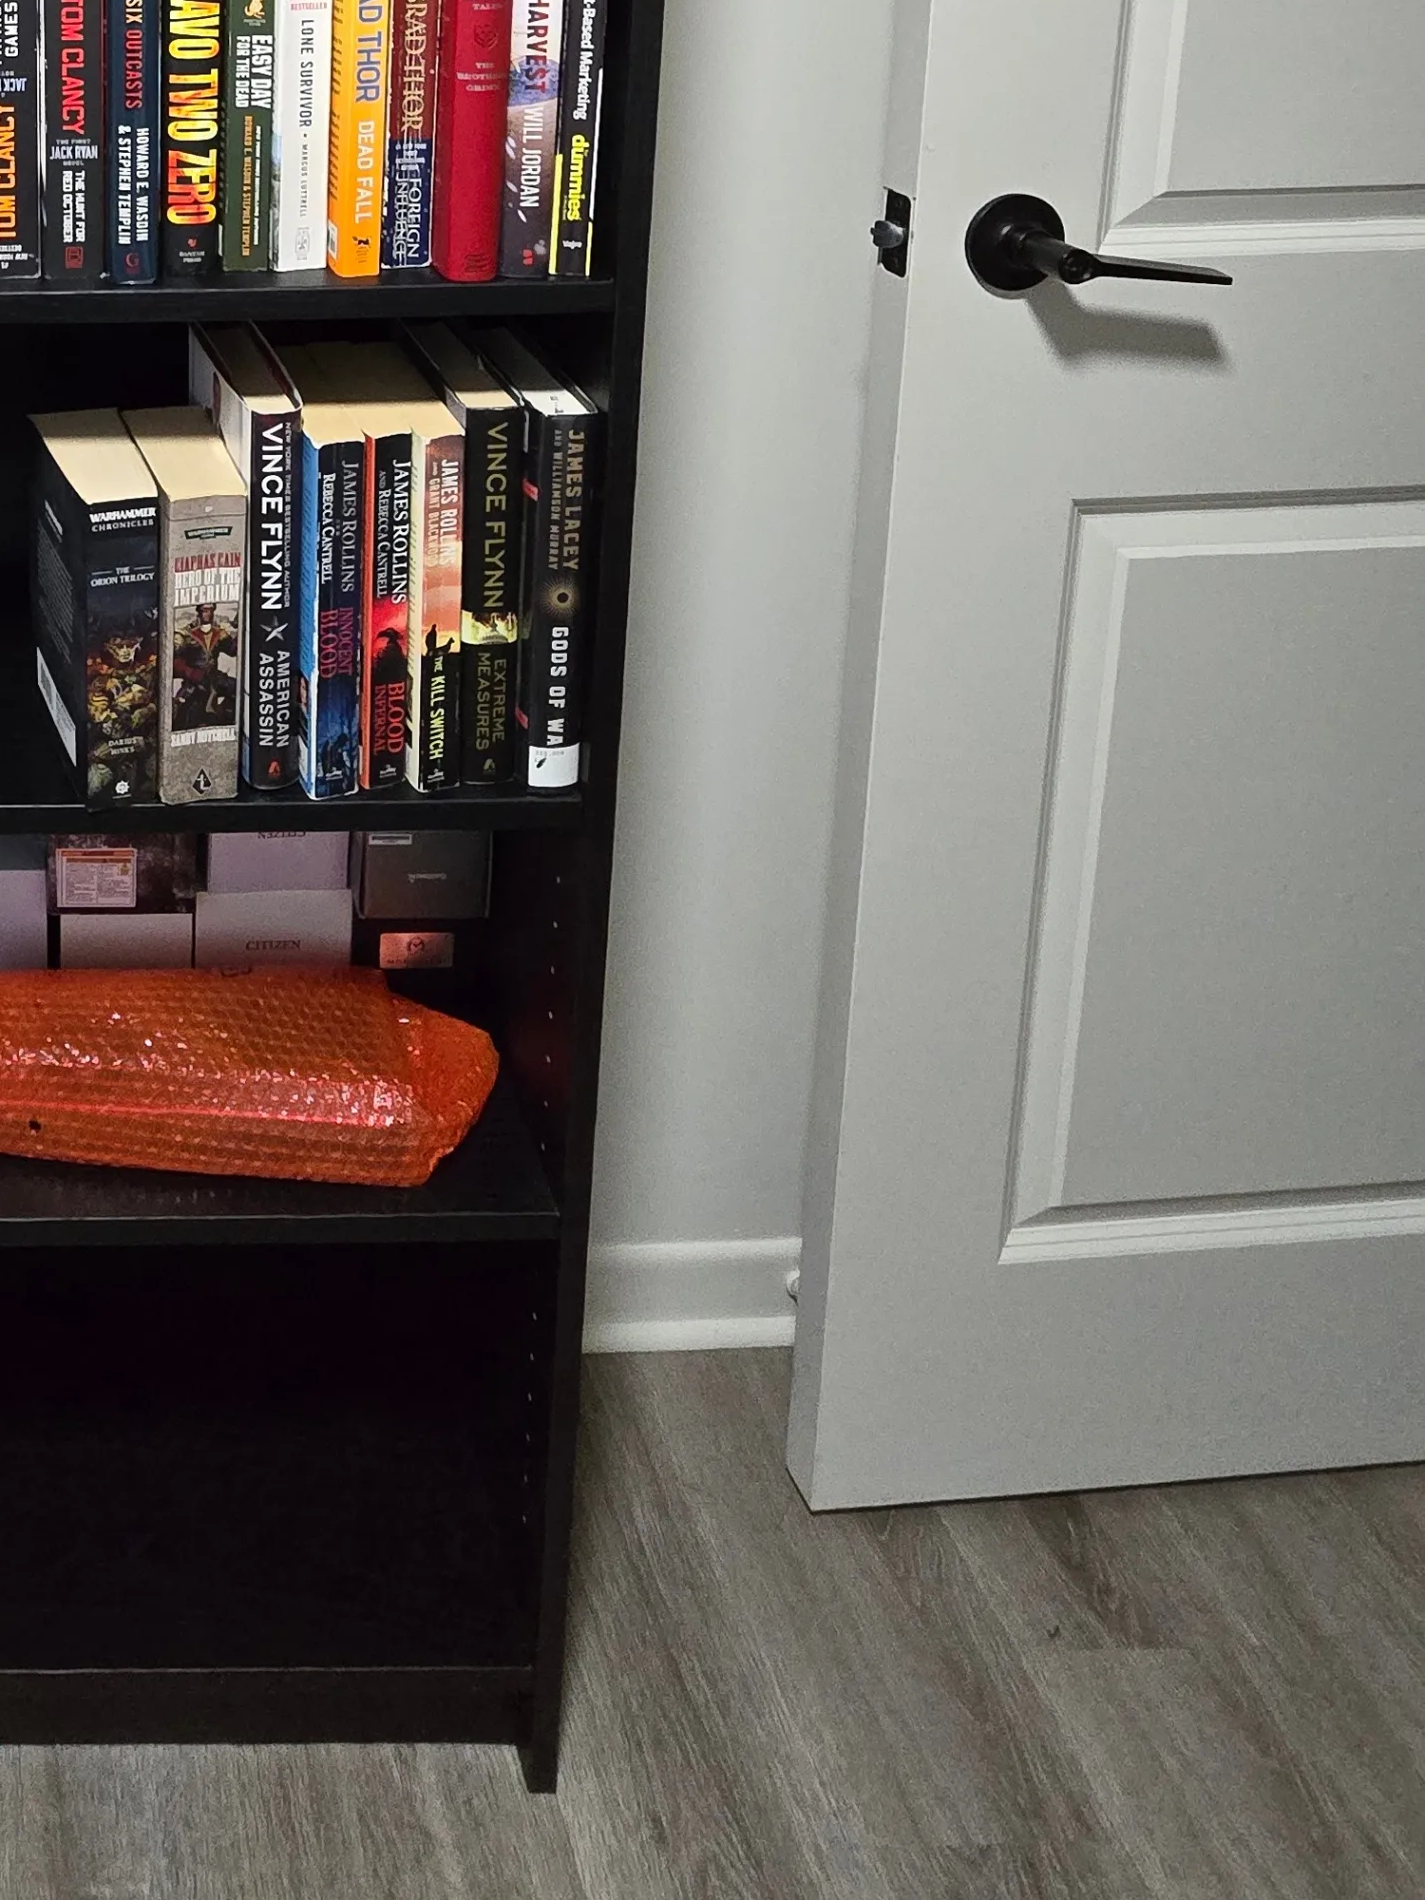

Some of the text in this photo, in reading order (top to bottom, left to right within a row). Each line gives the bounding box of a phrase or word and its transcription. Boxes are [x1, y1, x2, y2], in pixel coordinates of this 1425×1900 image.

[4, 2, 18, 58] GAMES
[291, 2, 327, 11] BESTSELLER
[125, 29, 142, 109] OUTCASTS
[251, 34, 273, 107] EASY DAY
[300, 20, 313, 127] LONE SURVIVOR
[355, 31, 382, 102] THOR
[526, 0, 553, 94] HARVEST
[61, 47, 85, 134] CLANCY
[169, 70, 218, 142] TWO
[357, 122, 374, 168] DEAD
[522, 106, 544, 143] WILL
[168, 149, 217, 224] ZERO
[301, 144, 309, 178] MARCUS
[519, 147, 542, 208] JORDAN
[355, 175, 372, 223] FALL
[261, 424, 284, 611] VINCE FLYNN
[550, 452, 560, 526] WILLIAMSON
[92, 520, 154, 532] CHRONICLES
[391, 459, 411, 604] JAMES ROLLINS
[548, 531, 558, 570] MURRAY
[91, 573, 154, 586] ORION TRILOGY
[246, 940, 301, 950] CITIZEN
